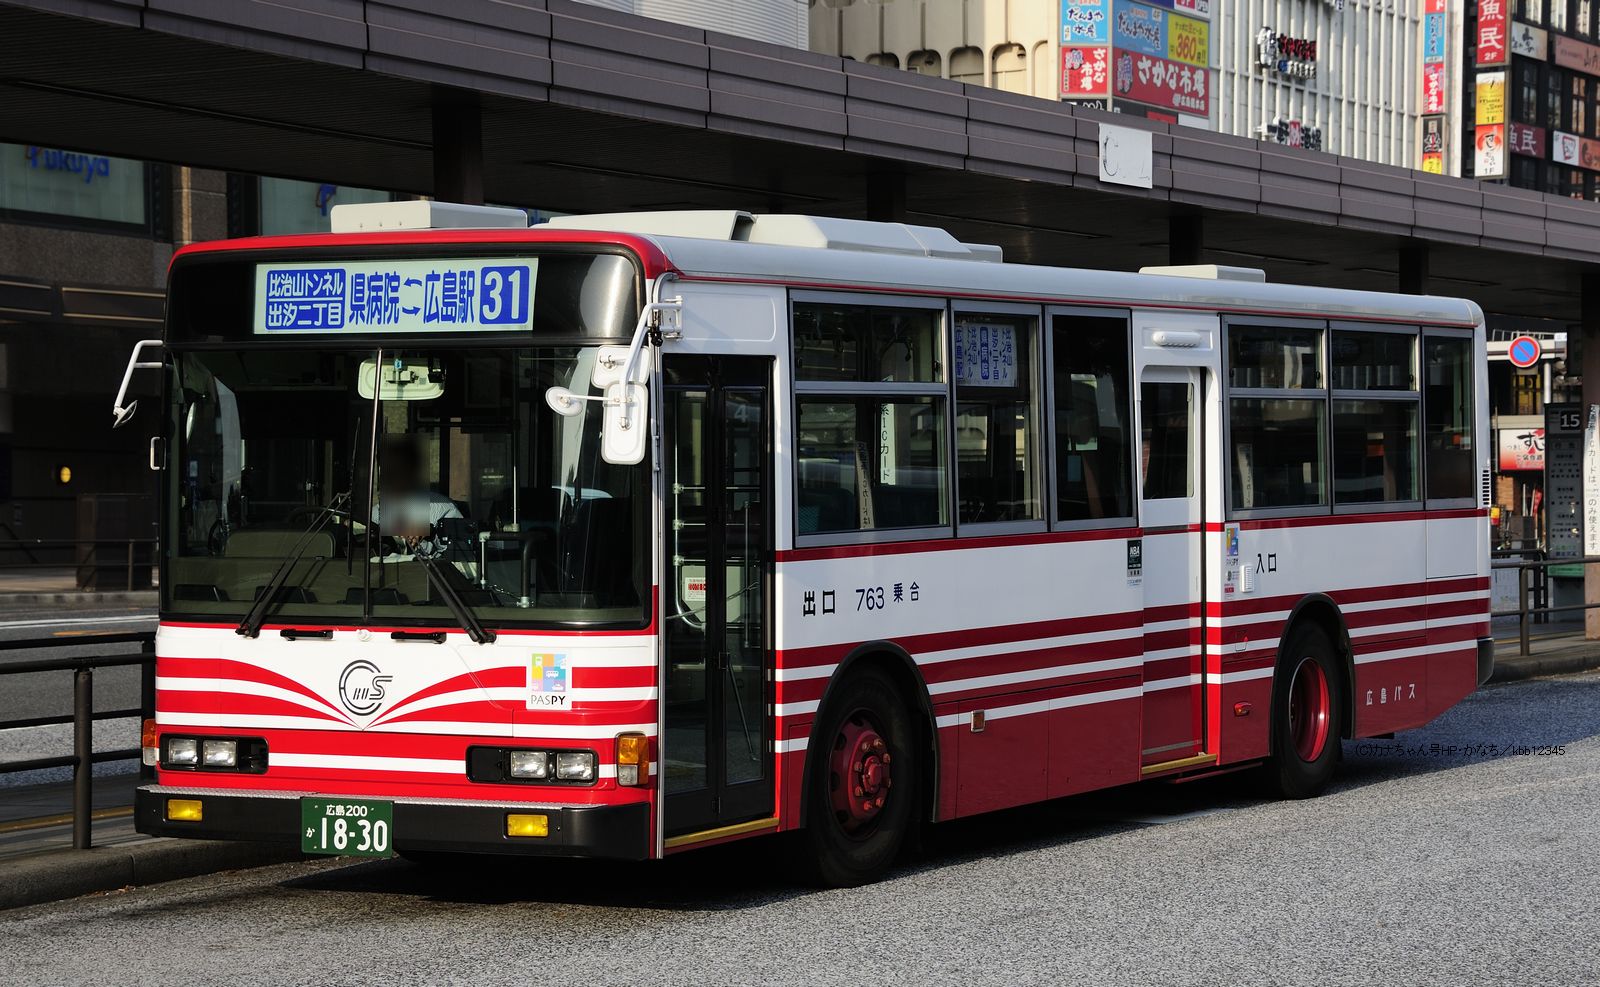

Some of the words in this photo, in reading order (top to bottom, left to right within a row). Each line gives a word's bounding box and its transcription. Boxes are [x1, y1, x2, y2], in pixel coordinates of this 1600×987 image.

[1478, 0, 1504, 50] 魚民
[1092, 48, 1106, 84] さかな
[1484, 52, 1498, 61] 2F
[1080, 62, 1093, 92] 市場
[1137, 55, 1205, 98] さかな市場
[268, 272, 343, 298] 比治山トンネル
[349, 271, 400, 326] 県病院
[422, 269, 475, 325] 広島駅
[482, 269, 523, 320] 31
[267, 302, 342, 327] 出汐二丁目
[1561, 413, 1581, 428] 15
[1256, 553, 1277, 574] 入口
[803, 590, 836, 617] 出口
[855, 586, 885, 612] 763
[893, 581, 920, 603] 乗合
[530, 694, 566, 706] PASPY
[1366, 683, 1416, 706] 広島バス
[326, 804, 368, 817] 広島200
[306, 827, 316, 839] か
[321, 817, 388, 851] 18-30
